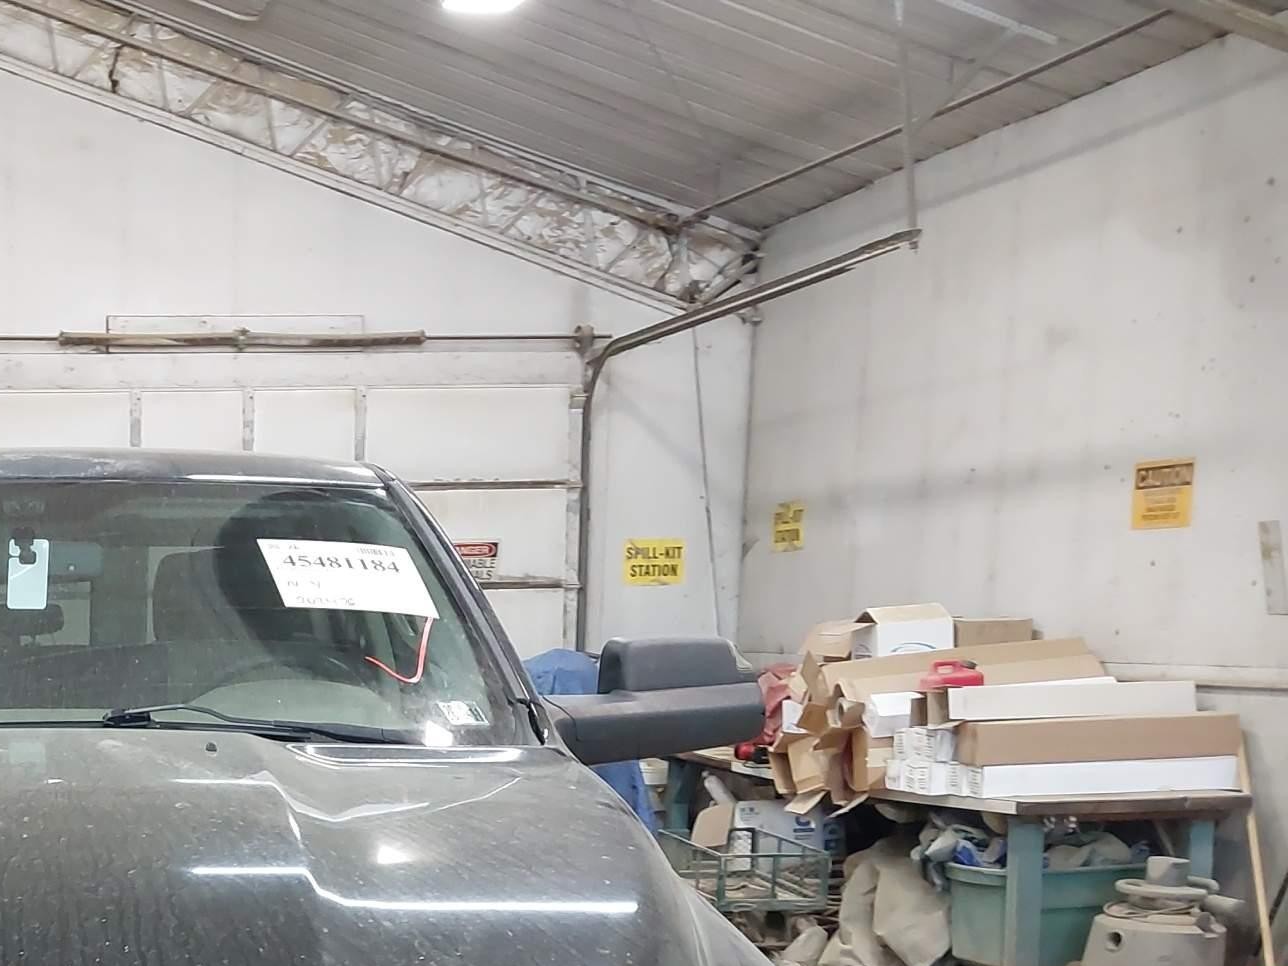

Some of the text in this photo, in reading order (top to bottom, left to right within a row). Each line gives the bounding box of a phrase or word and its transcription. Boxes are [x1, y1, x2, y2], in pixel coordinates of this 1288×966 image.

[626, 545, 683, 560] SPILL-KIT
[283, 554, 400, 573] 45481184
[630, 563, 679, 577] STATION
